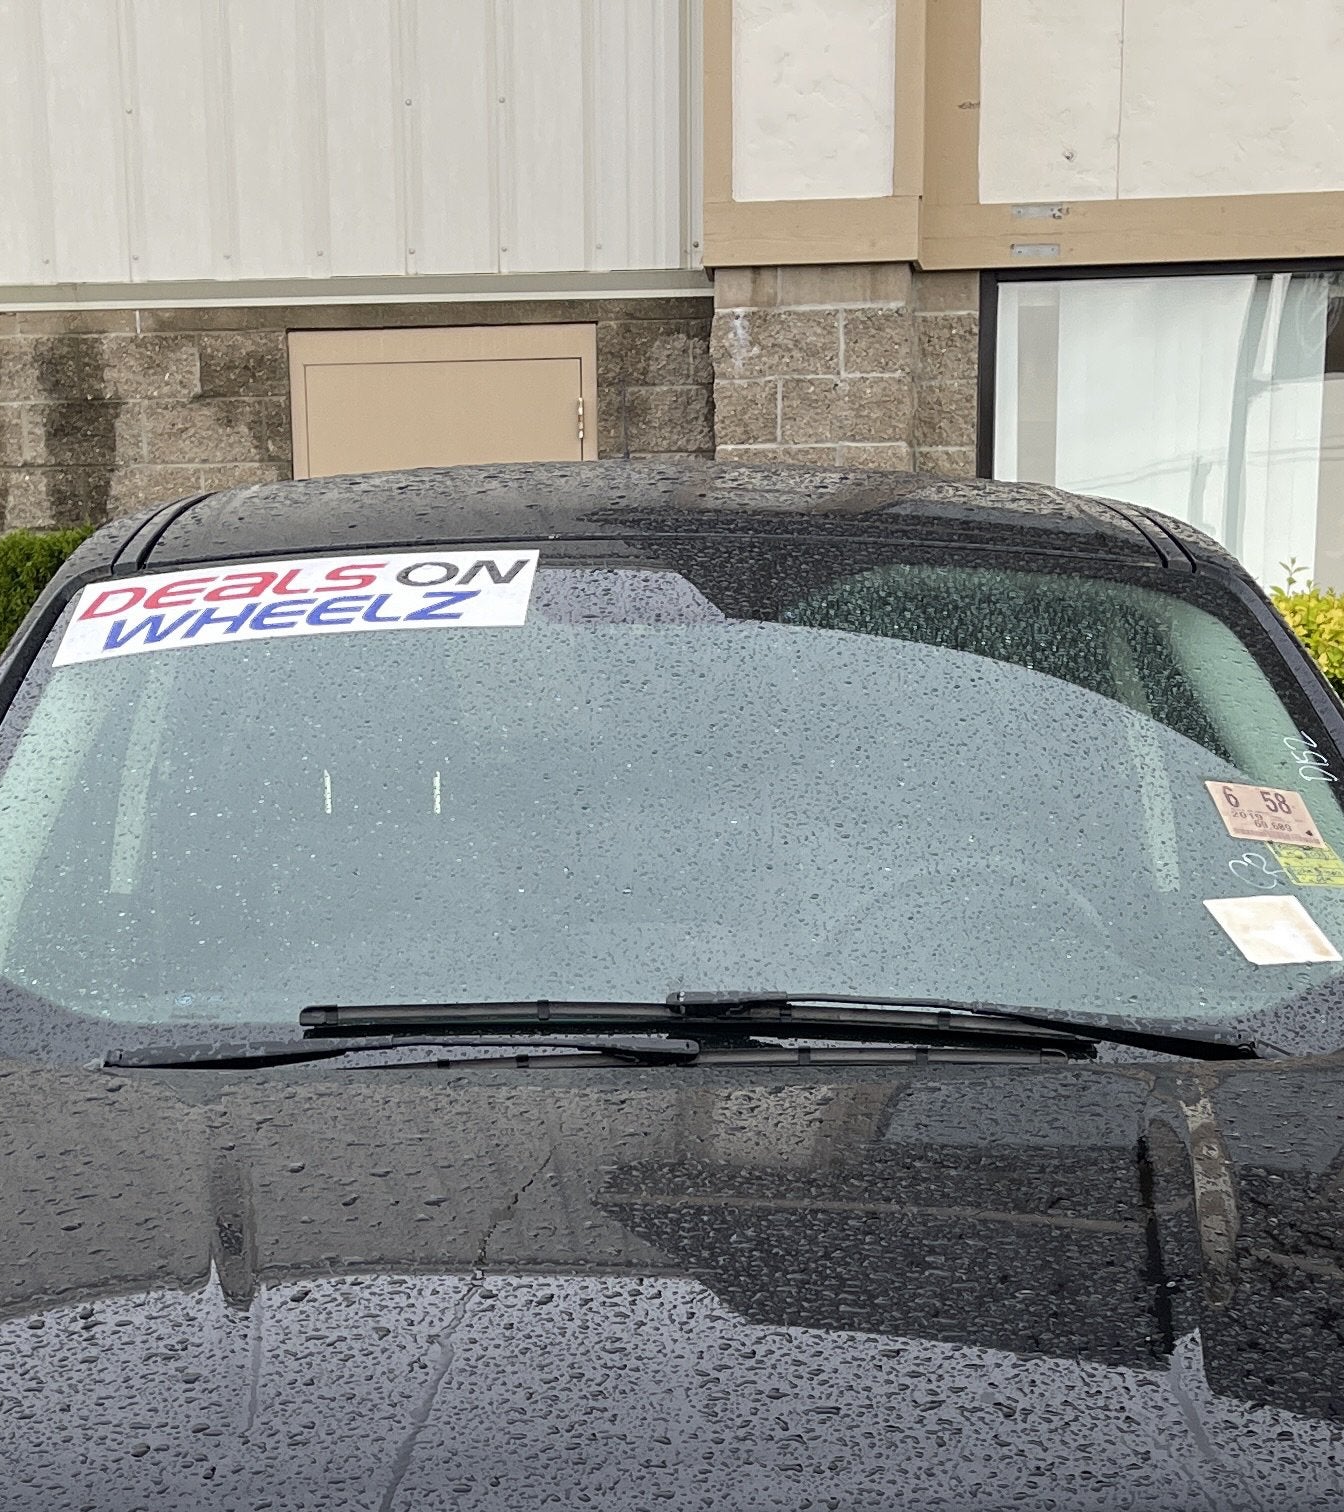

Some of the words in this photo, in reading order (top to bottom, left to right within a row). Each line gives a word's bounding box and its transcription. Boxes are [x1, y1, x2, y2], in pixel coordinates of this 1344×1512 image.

[395, 558, 531, 587] ON
[101, 590, 482, 652] WHEELZ
[1222, 785, 1240, 808] 6
[1259, 790, 1293, 815] 58
